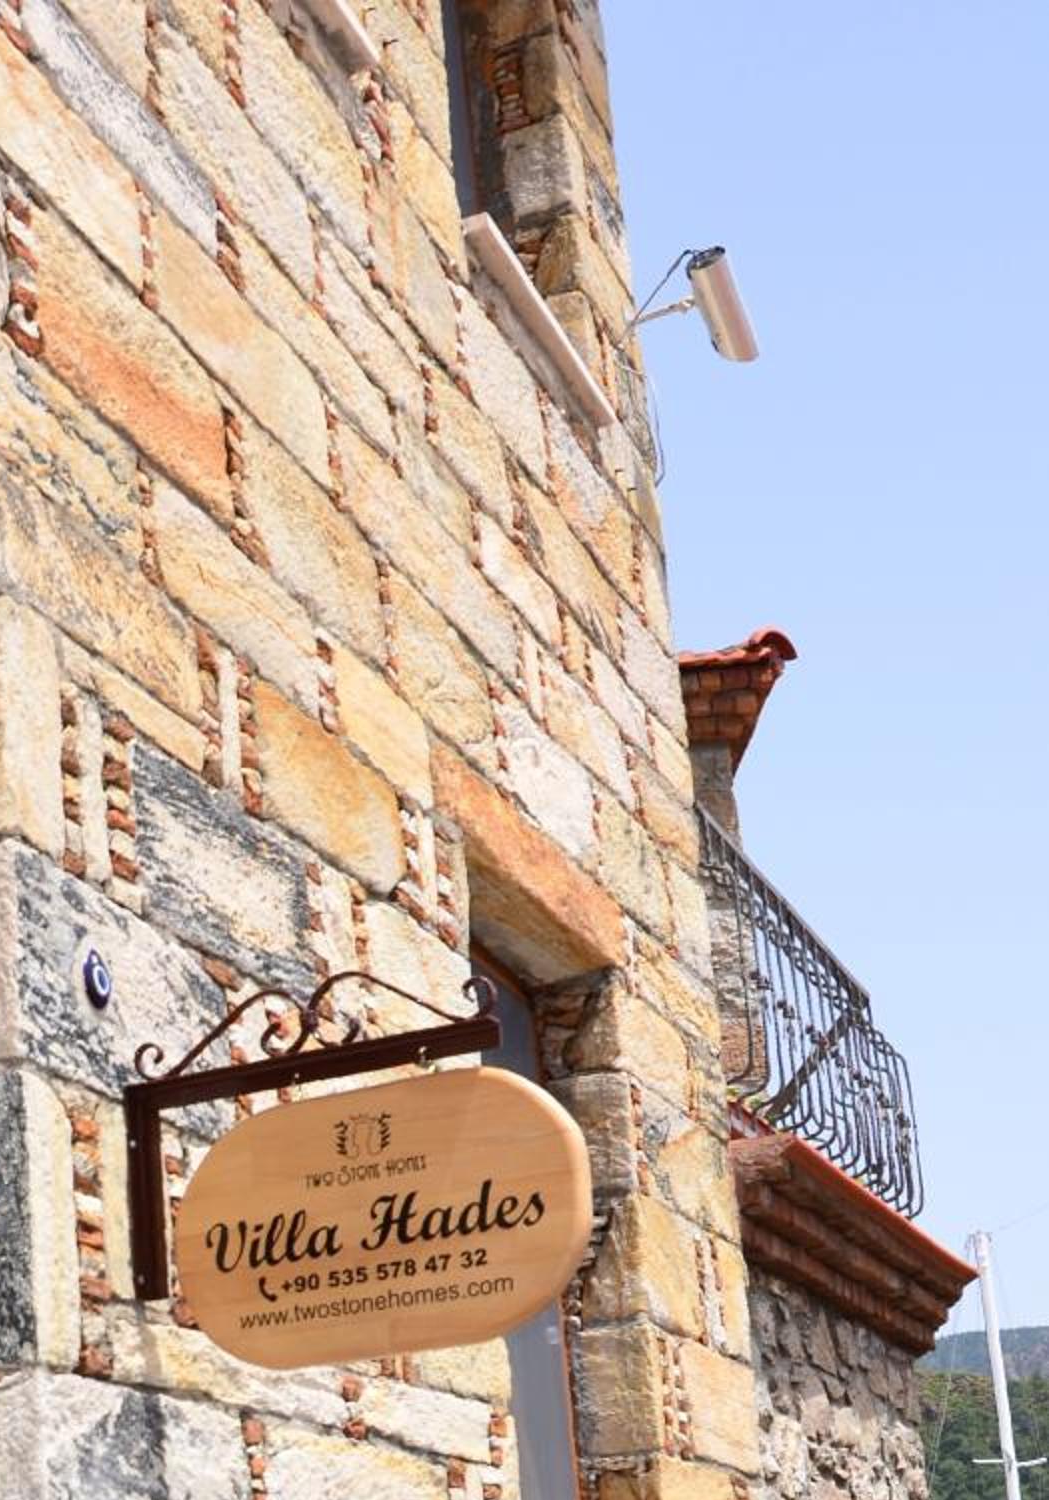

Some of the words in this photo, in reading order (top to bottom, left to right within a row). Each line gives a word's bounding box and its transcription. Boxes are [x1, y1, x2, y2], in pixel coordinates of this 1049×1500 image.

[206, 1209, 343, 1273] Villa
[361, 1179, 545, 1250] Hades
[281, 1273, 320, 1293] +90
[328, 1266, 368, 1287] 535
[376, 1259, 417, 1281] 578
[424, 1254, 452, 1273] 47
[460, 1248, 488, 1269] 32
[239, 1276, 515, 1329] www.twostonehomes.com
